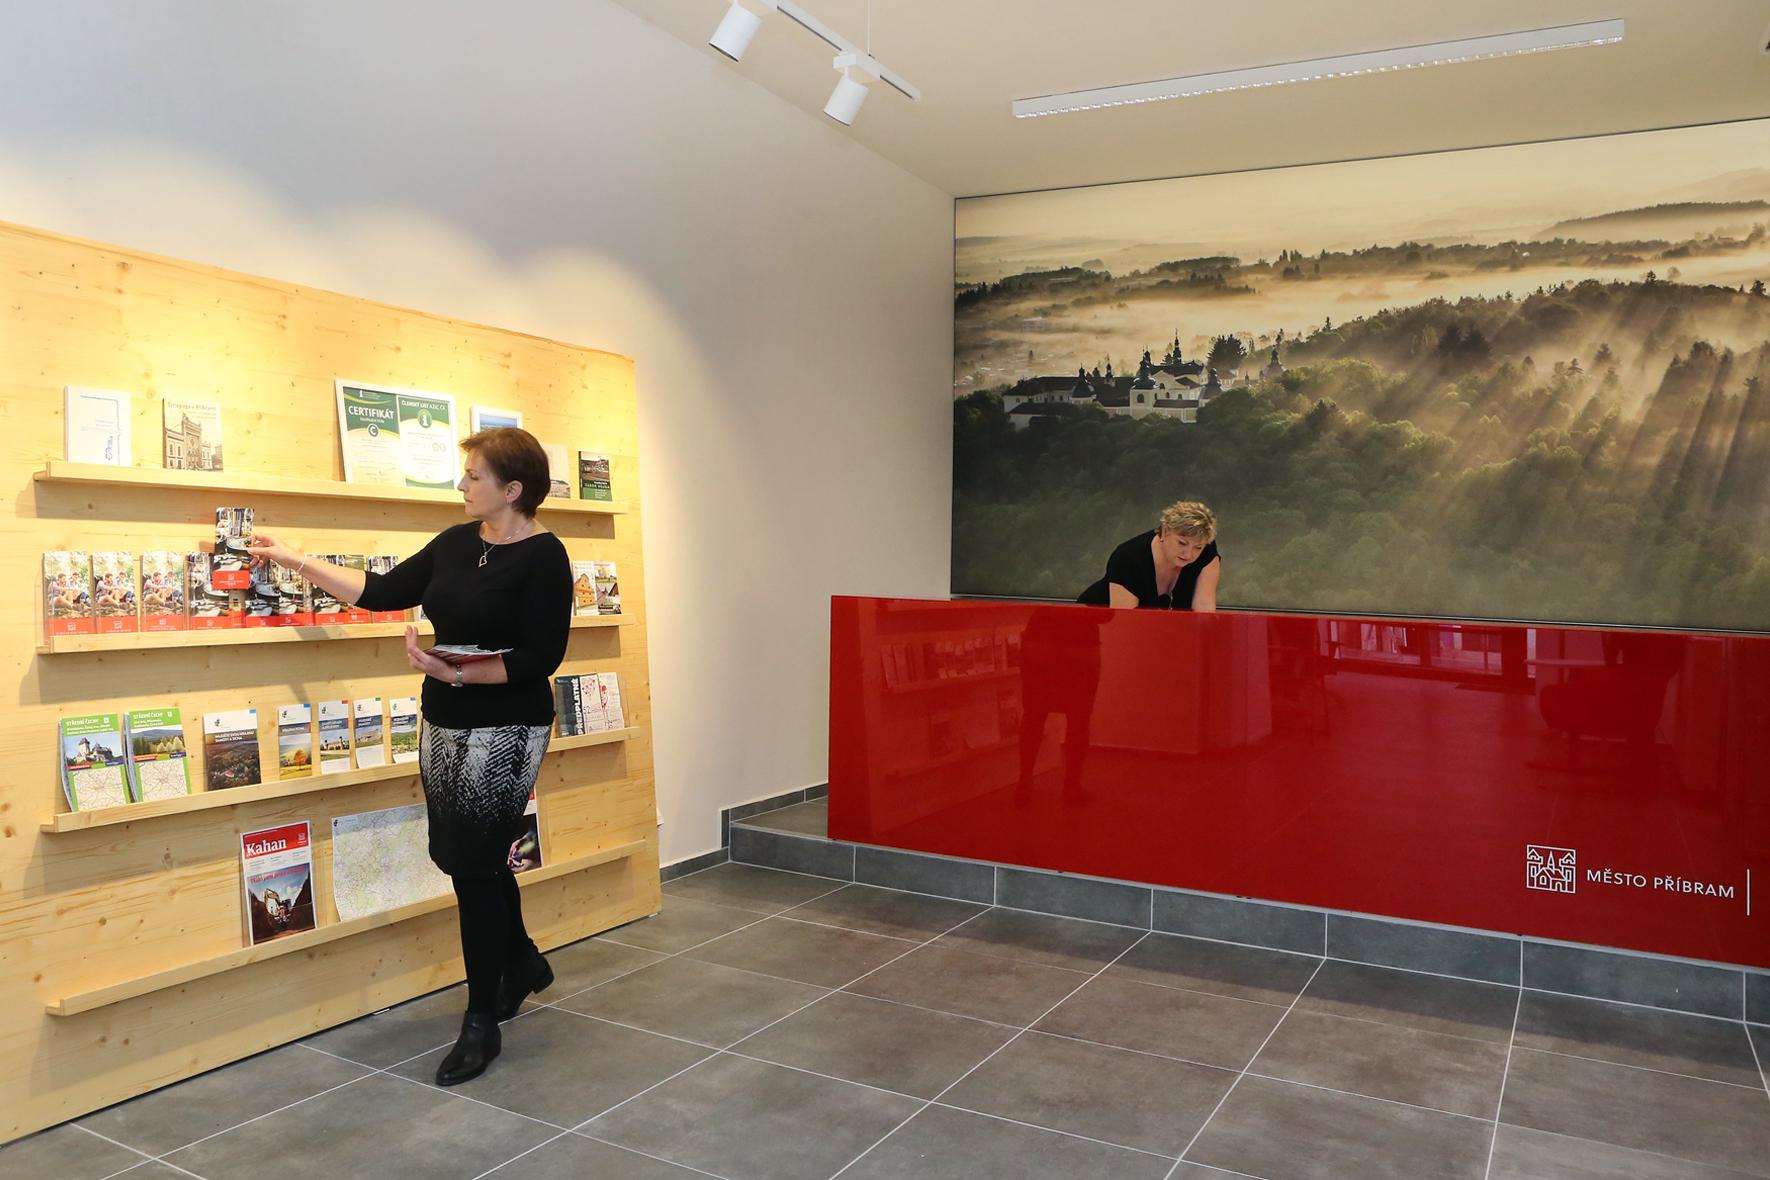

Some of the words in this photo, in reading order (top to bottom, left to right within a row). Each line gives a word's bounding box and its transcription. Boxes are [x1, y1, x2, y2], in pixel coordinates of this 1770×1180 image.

[348, 405, 394, 419] CERTIFIKÁT
[246, 838, 287, 855] Kahan
[1586, 868, 1647, 888] MĚSTO
[1653, 876, 1734, 898] PŘÍBRAM
